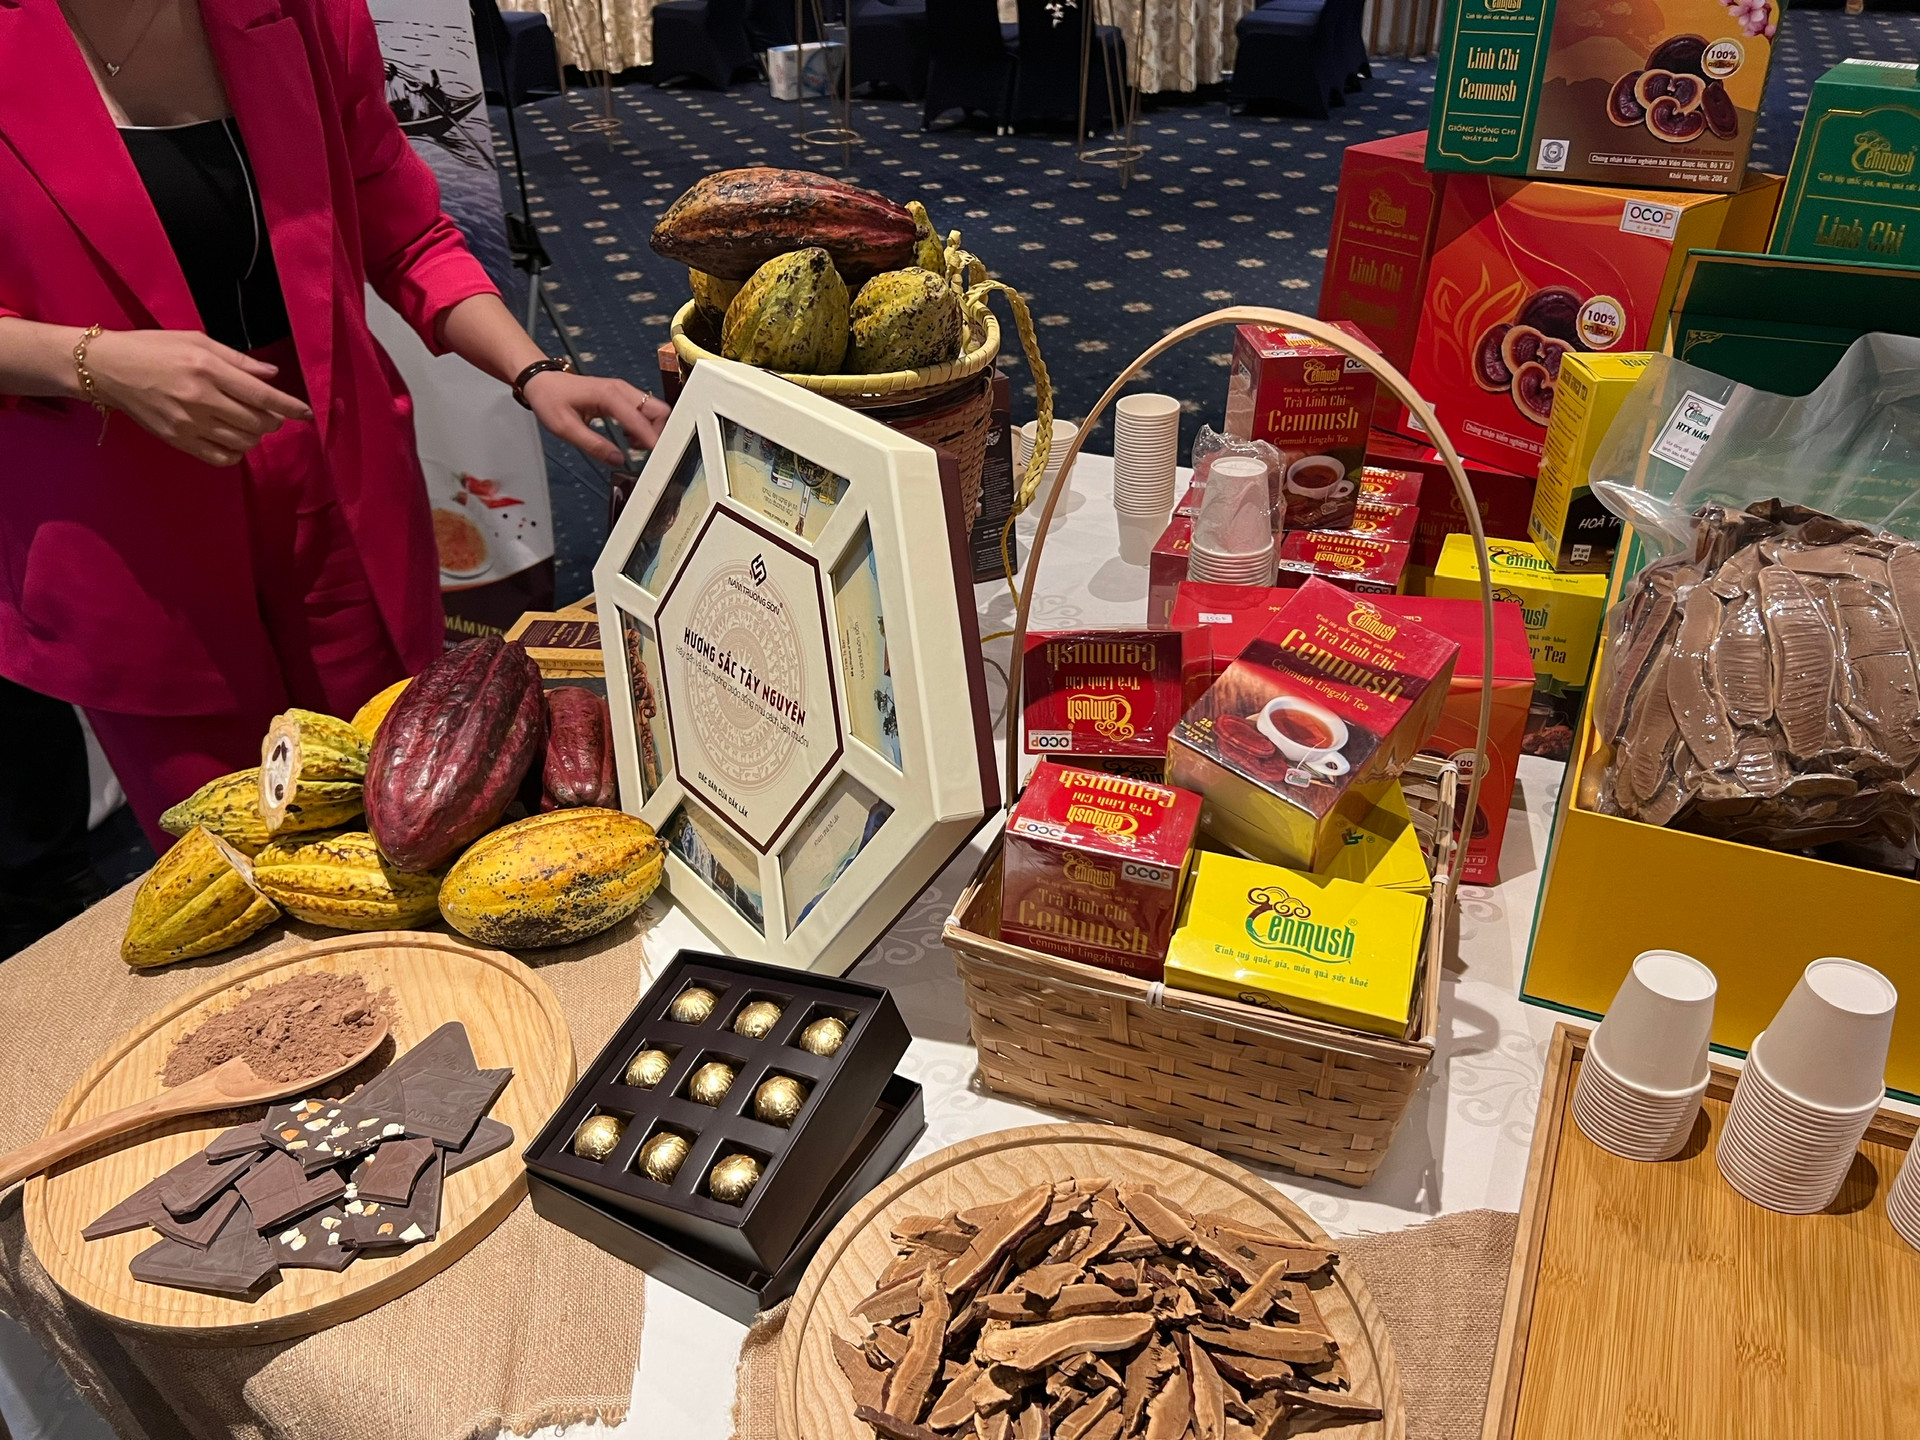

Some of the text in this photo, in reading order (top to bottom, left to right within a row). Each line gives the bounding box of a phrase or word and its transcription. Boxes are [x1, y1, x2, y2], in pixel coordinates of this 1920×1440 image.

[1467, 47, 1520, 70] Linh Chi
[1711, 50, 1737, 60] 100%
[1459, 77, 1517, 101] Cenmush
[1630, 206, 1674, 224] OCOP
[1814, 215, 1905, 254] Linh Chi
[1350, 256, 1403, 292] Linh Chi
[1588, 310, 1616, 326] 100%
[1303, 359, 1341, 386] Cenmush
[1284, 395, 1346, 408] Trà Linh Chi
[1268, 407, 1359, 432] Cenmush
[1676, 422, 1692, 434] HTX
[1309, 434, 1334, 446] Lingzhi
[1578, 515, 1606, 529] HOÀ
[1348, 601, 1398, 642] Cenmush
[1047, 643, 1156, 672] Cenmush
[1315, 624, 1397, 671] Trà Linh Chi
[1544, 644, 1566, 664] Tea
[684, 627, 806, 728] HƯƠNG SẮC TÂY NGUYÊN
[1280, 628, 1405, 704] Cenmush
[1065, 676, 1140, 690] Trà Linh Chi
[1272, 658, 1369, 712] Cenmush Lingzhi Tea
[1067, 694, 1135, 742] Cenmush
[1200, 718, 1212, 728] 25
[1032, 736, 1070, 748] OCOP
[1059, 770, 1176, 808] Cenmush
[1072, 792, 1152, 816] Trà Linh Chi
[1067, 804, 1139, 844] Cenmush
[1063, 850, 1116, 890] Cenmush
[1125, 864, 1170, 882] OCOP
[1038, 888, 1064, 907] Trà
[1069, 896, 1100, 917] Linh
[1104, 904, 1128, 922] Chi
[1019, 900, 1149, 955] Cenmush
[1245, 886, 1356, 964] Cenmush
[1028, 935, 1136, 969] Cenmush Lingzhi Tea
